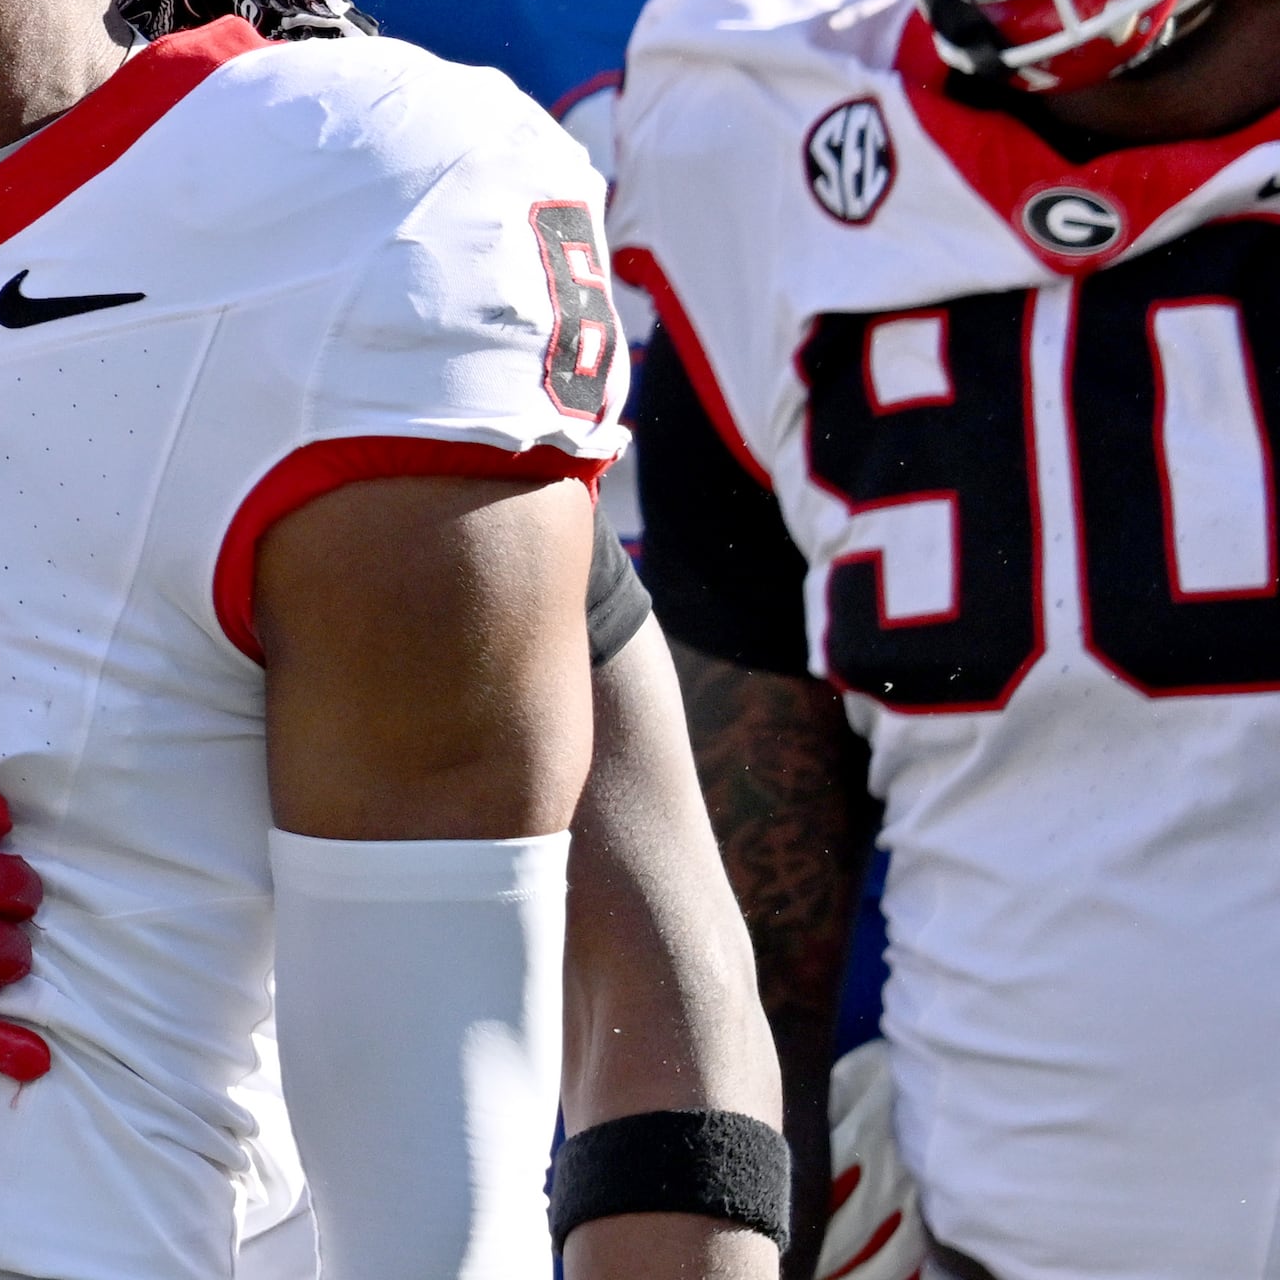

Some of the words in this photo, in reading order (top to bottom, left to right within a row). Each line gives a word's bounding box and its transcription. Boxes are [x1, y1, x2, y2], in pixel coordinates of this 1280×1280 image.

[807, 99, 891, 223] SEC
[528, 199, 617, 423] 6
[794, 212, 1280, 716] 90
